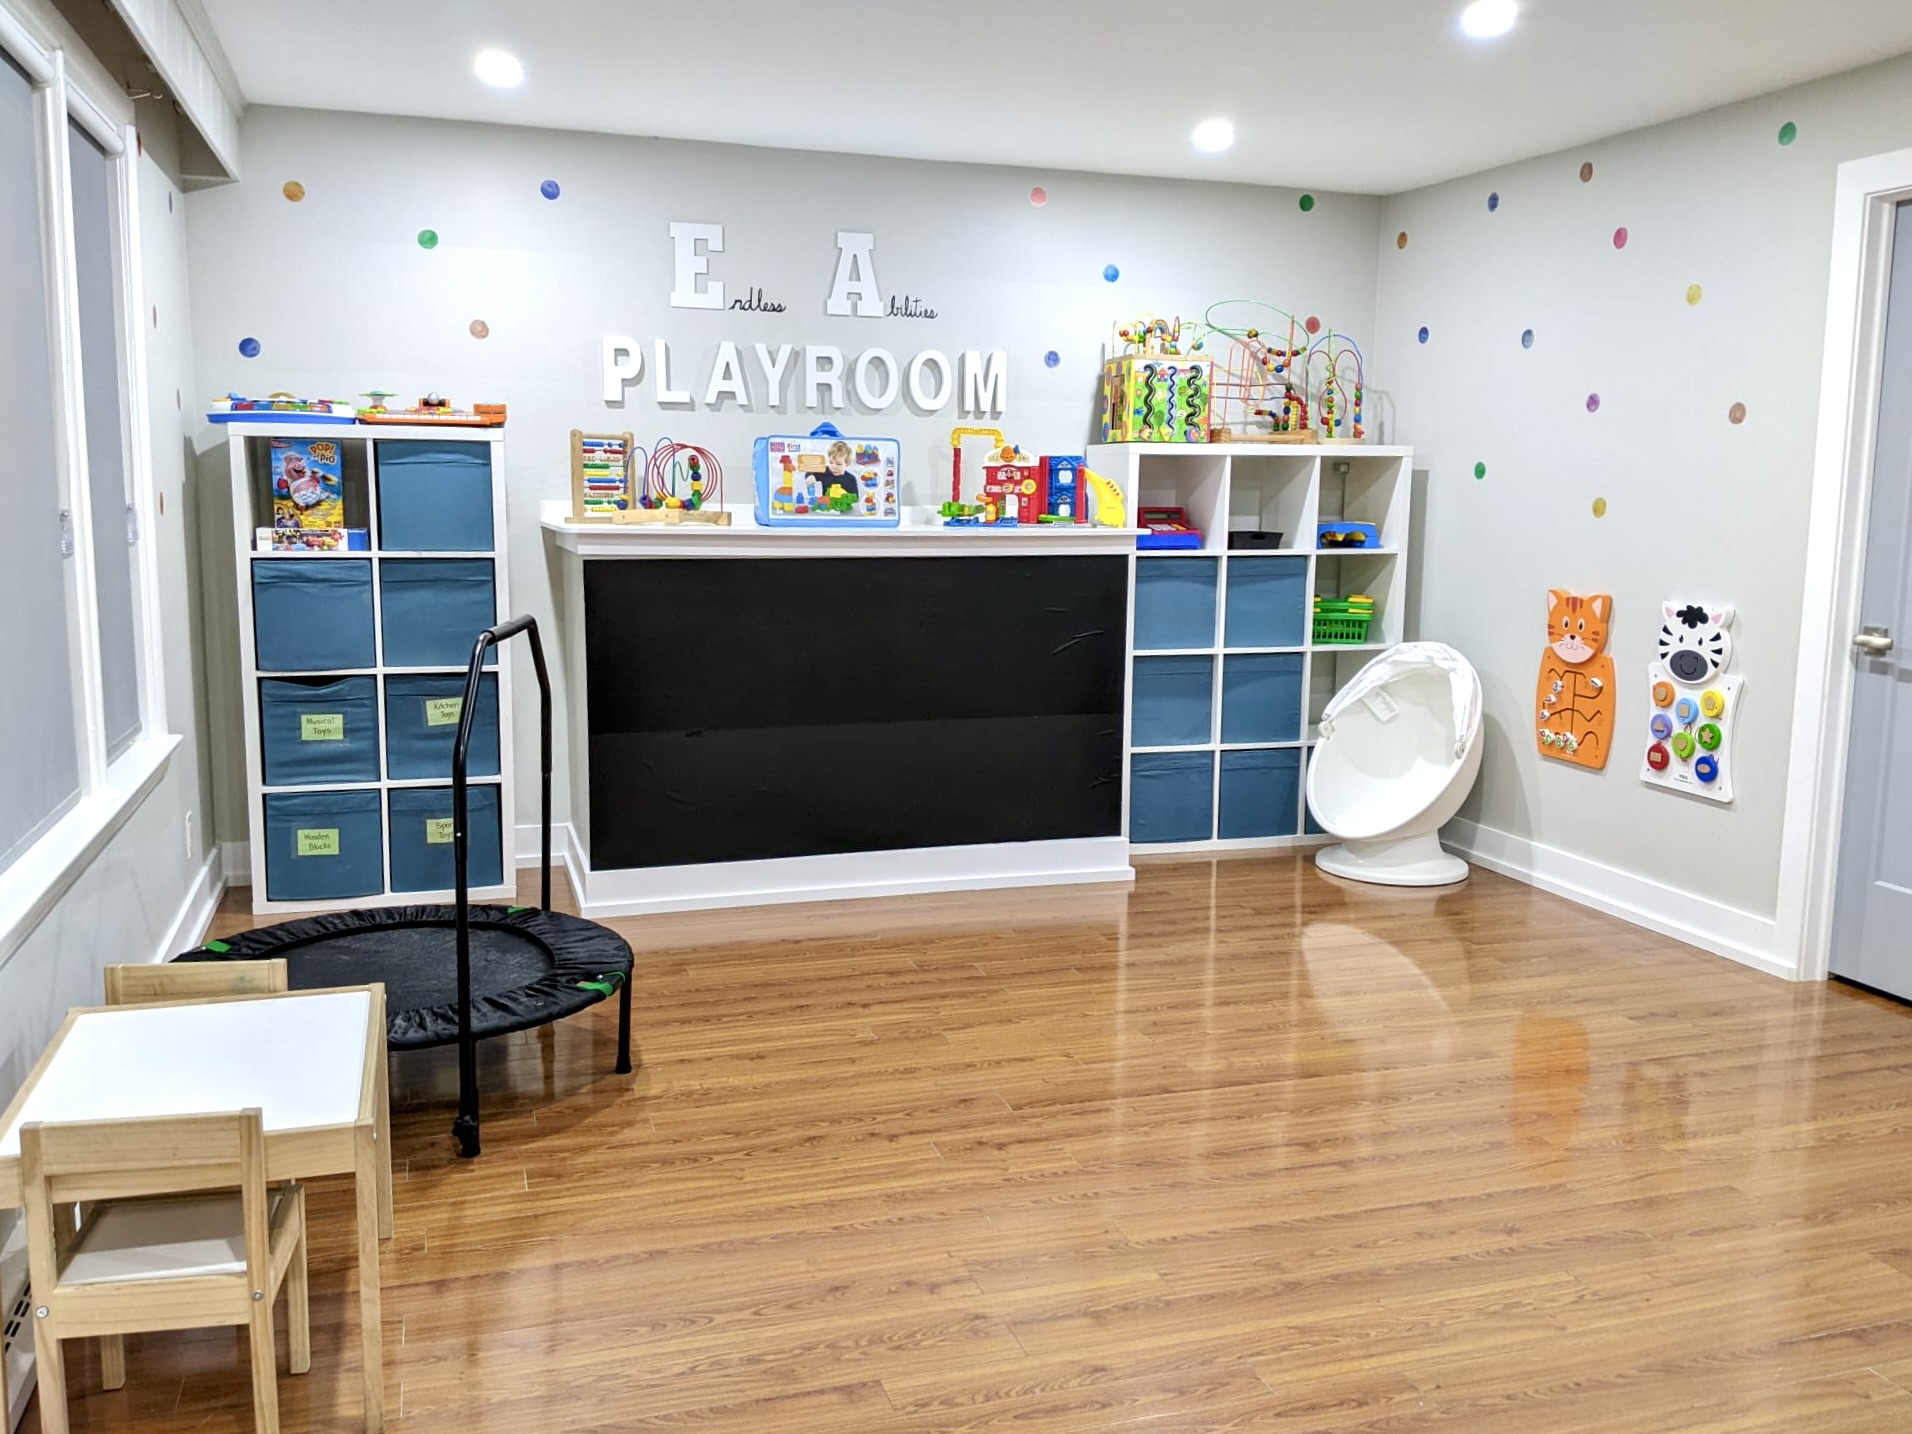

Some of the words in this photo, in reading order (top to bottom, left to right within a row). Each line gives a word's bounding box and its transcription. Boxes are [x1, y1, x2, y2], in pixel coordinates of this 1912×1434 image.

[602, 334, 1008, 412] PLAYROOM
[309, 442, 336, 455] POP!
[433, 702, 460, 710] Kitchen
[441, 711, 455, 719] Toys
[306, 717, 335, 726] Musical
[312, 727, 332, 737] Toys
[303, 832, 330, 840] Wooden
